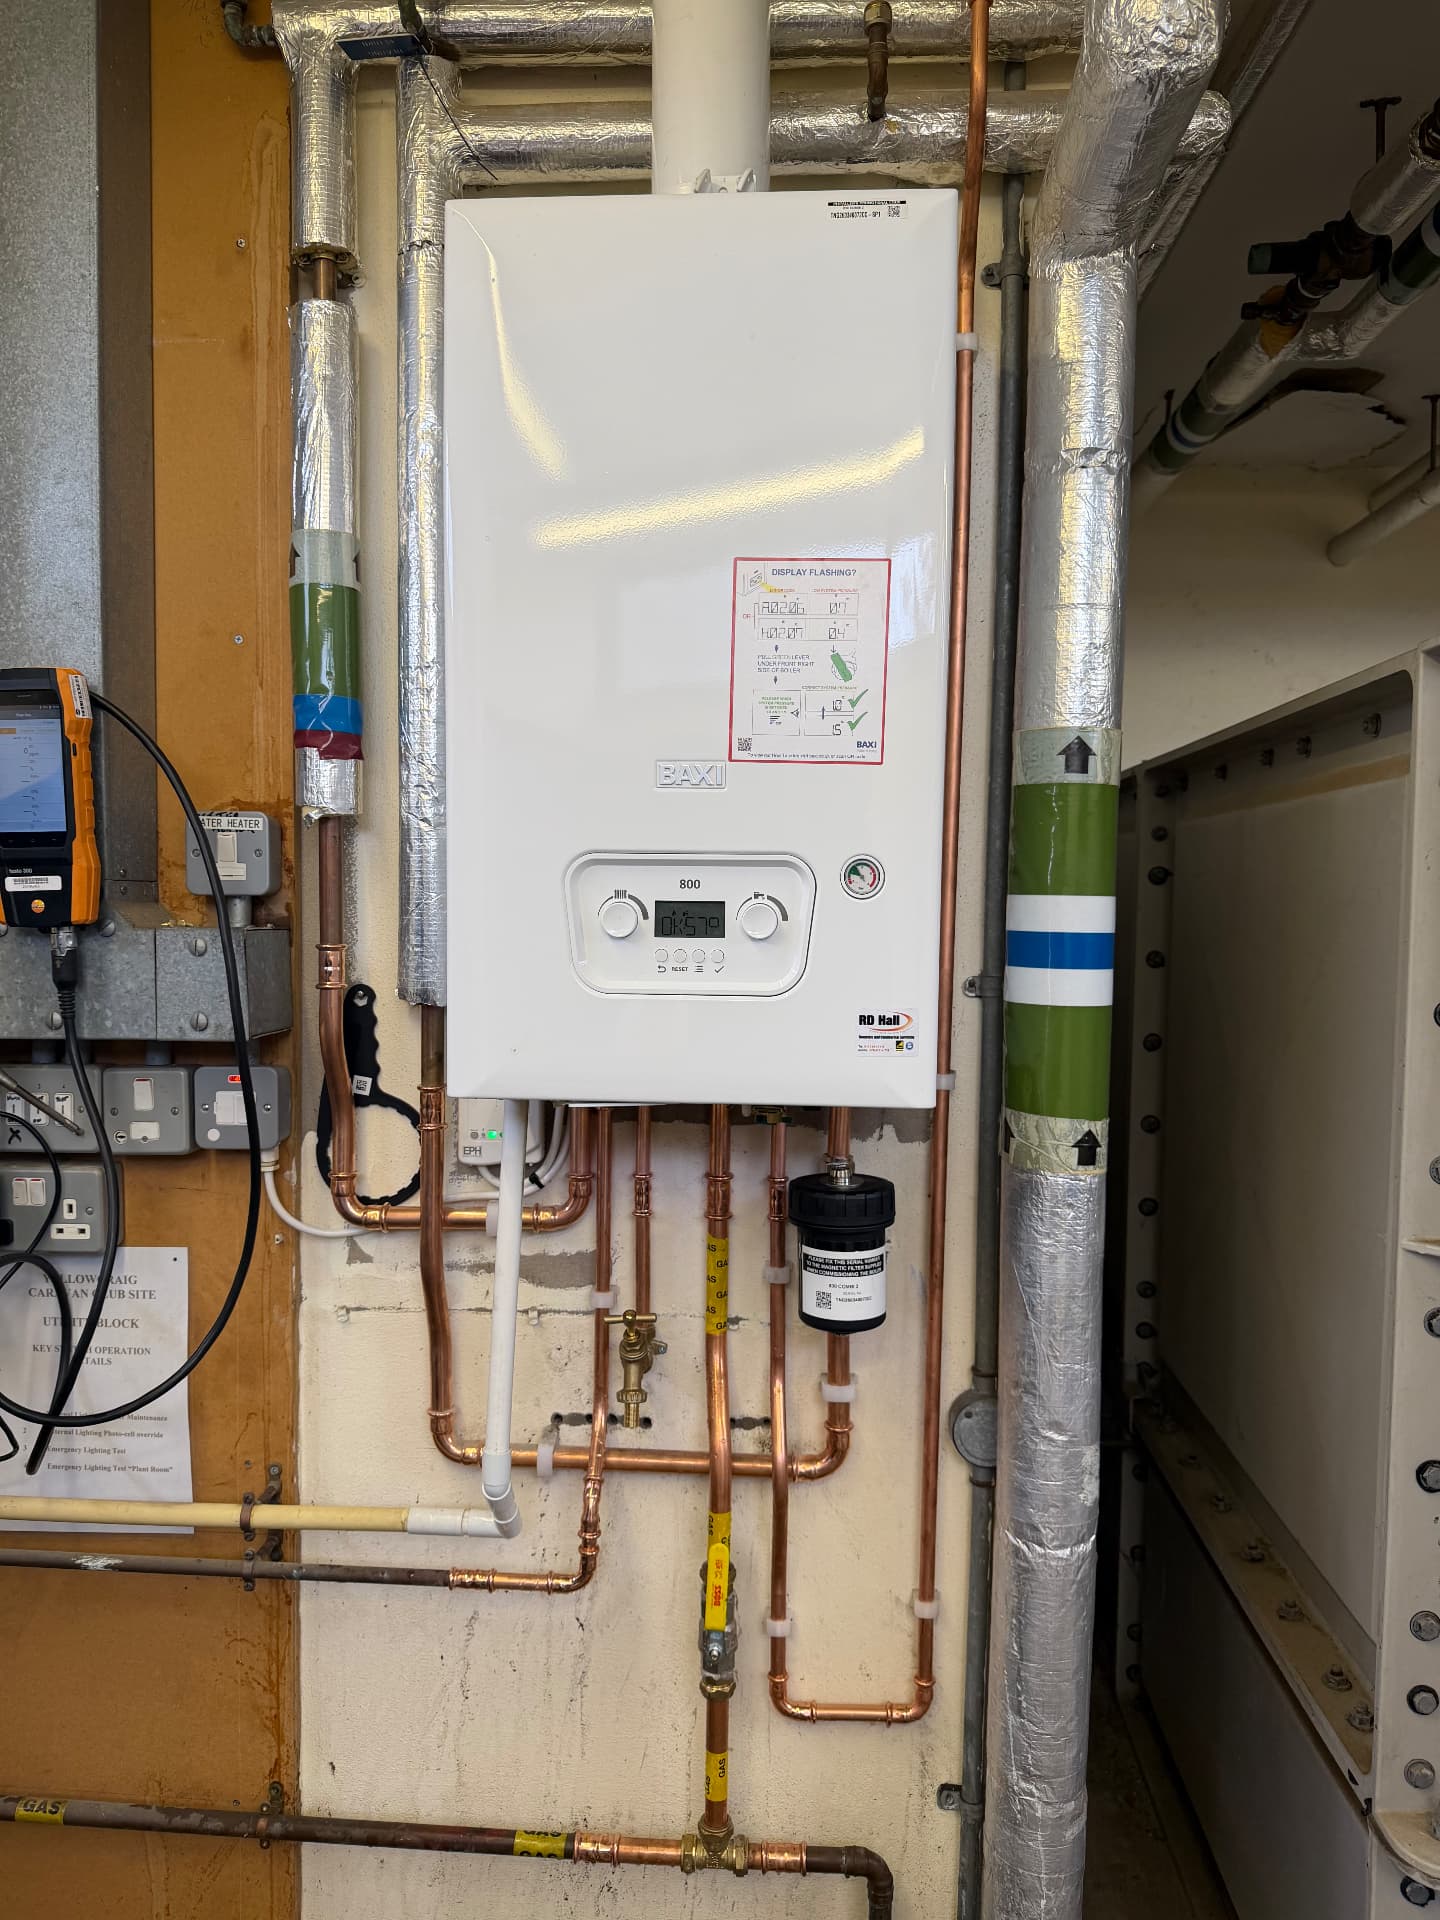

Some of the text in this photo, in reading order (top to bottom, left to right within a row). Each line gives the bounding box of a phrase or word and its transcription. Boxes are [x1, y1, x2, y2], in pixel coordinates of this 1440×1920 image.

[772, 568, 856, 576] DISPLAY FLASHING?
[658, 764, 723, 785] BAXI
[201, 819, 260, 828] ATER HEATER
[680, 879, 700, 889] 800
[859, 1015, 900, 1025] RD Hall
[464, 1147, 481, 1155] EPH
[29, 1288, 88, 1298] CARAN
[128, 1290, 157, 1300] SITE
[96, 1318, 140, 1328] BLOCK
[95, 1347, 151, 1355] OPERATION
[75, 1429, 102, 1437] Lighting
[47, 1447, 81, 1455] Emergency
[84, 1447, 111, 1455] Lighting
[47, 1463, 82, 1471] Emergency
[84, 1464, 112, 1472] Lighting
[23, 1799, 62, 1814] GAS
